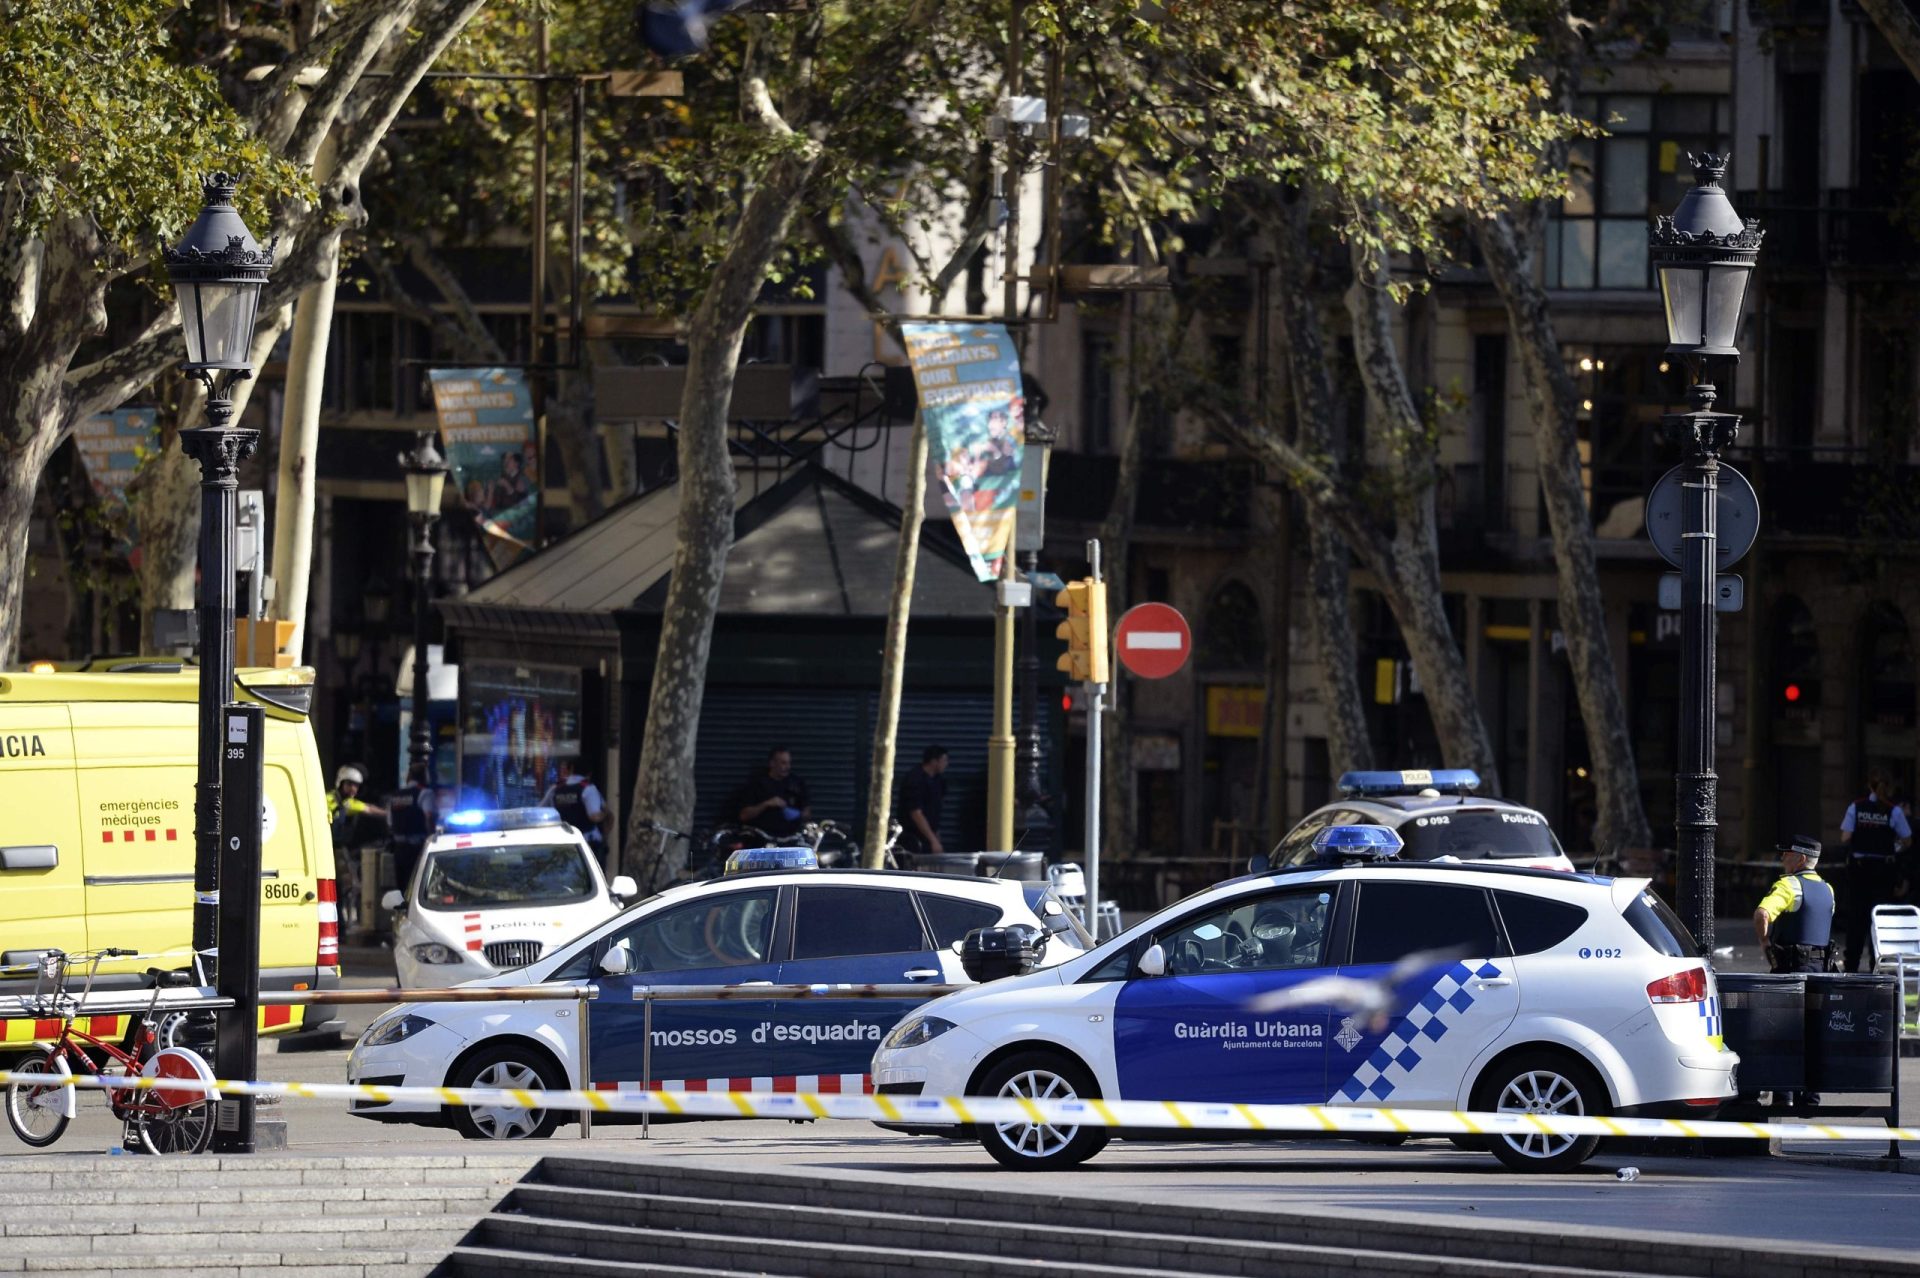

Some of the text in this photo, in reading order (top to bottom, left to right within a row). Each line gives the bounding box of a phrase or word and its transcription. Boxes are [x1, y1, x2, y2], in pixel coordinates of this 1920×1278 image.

[921, 367, 952, 386] OUR
[925, 380, 1011, 405] EVERYDAYS
[227, 748, 245, 759] 395
[100, 799, 179, 813] emergències
[101, 814, 161, 827] mèdiques
[1430, 816, 1450, 825] 092
[265, 883, 299, 899] 8606
[1595, 948, 1622, 959] 092
[650, 1020, 881, 1046] mossos d'esquadra
[1174, 1021, 1322, 1039] Guàrdia Urbana
[1223, 1040, 1322, 1050] Ajuntament de Barcelona
